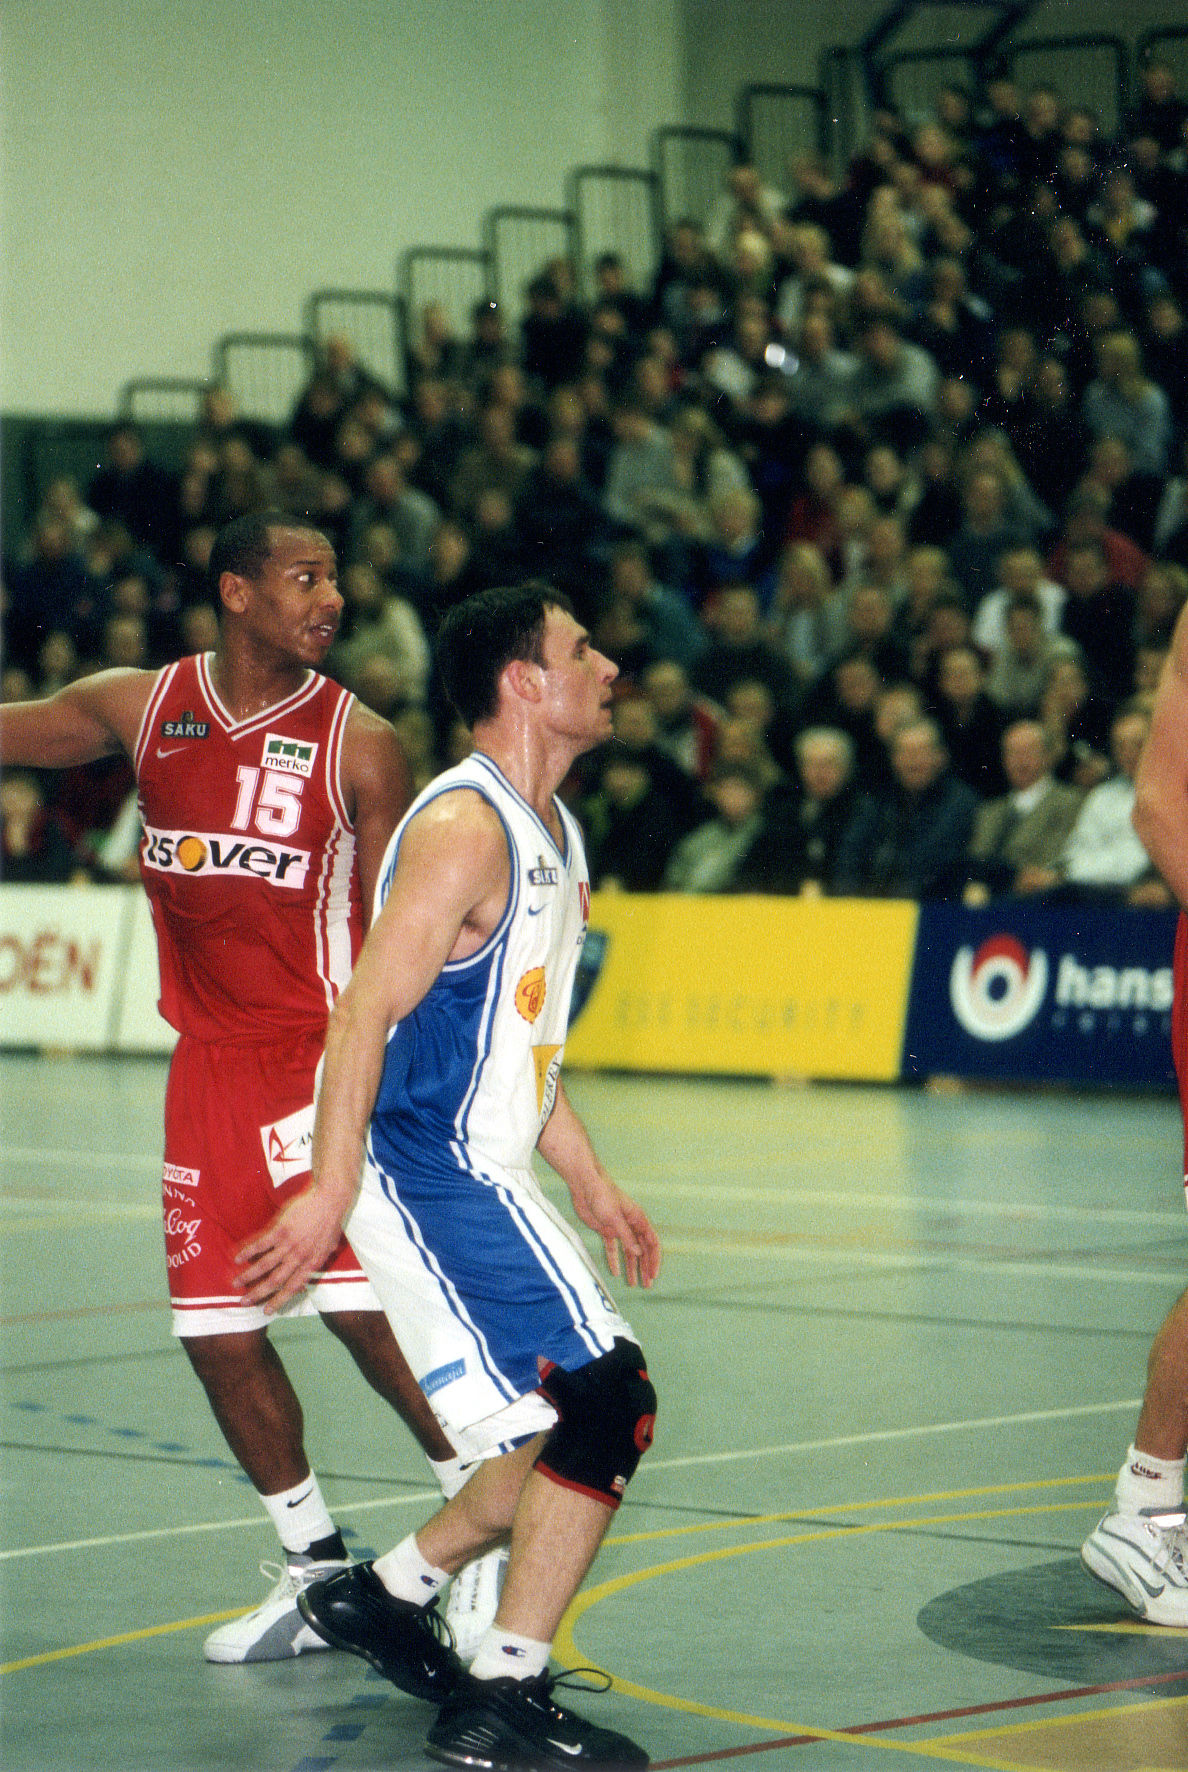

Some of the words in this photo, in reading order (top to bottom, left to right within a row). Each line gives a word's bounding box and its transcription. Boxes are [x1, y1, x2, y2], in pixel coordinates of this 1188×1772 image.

[164, 723, 207, 736] SAKU
[265, 756, 309, 773] merko
[230, 765, 304, 837] 15
